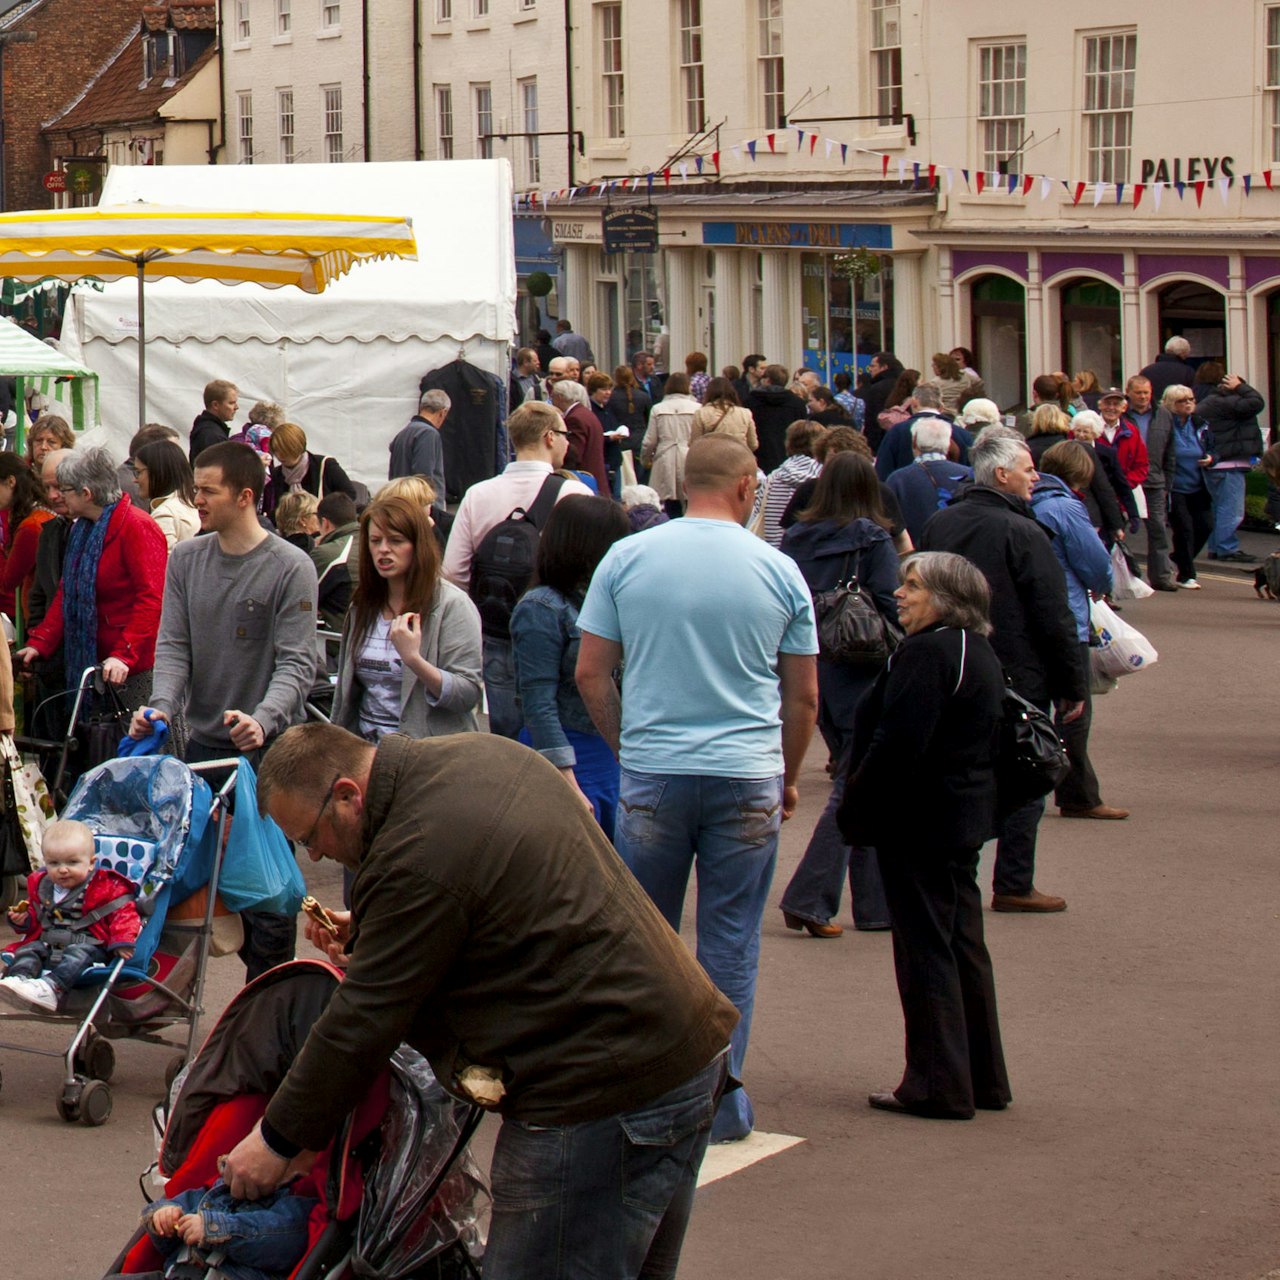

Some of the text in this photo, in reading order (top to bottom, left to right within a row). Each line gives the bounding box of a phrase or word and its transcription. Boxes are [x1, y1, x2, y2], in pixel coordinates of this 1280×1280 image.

[1141, 156, 1235, 190] PALEYS
[554, 223, 584, 239] SMASH
[736, 223, 790, 245] DICKENS
[808, 223, 840, 247] DELI
